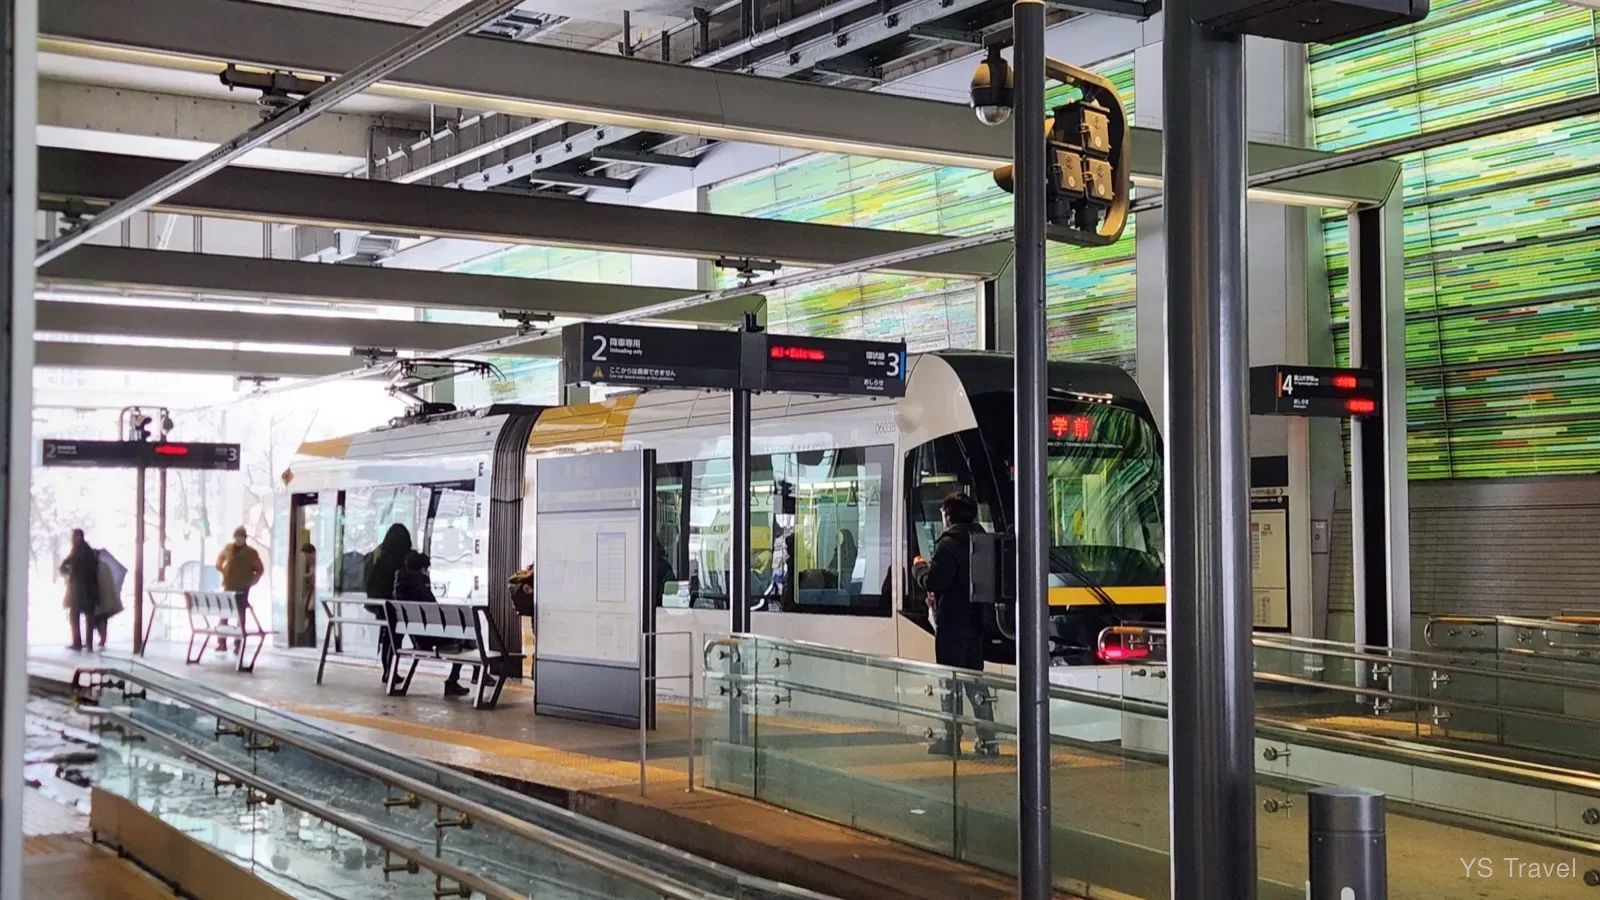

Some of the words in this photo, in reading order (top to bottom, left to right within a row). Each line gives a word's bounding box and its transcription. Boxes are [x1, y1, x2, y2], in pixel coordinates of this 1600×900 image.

[592, 335, 607, 361] 2
[886, 352, 899, 376] 3
[1282, 374, 1293, 395] 4
[46, 445, 56, 458] 2
[228, 448, 237, 461] 3
